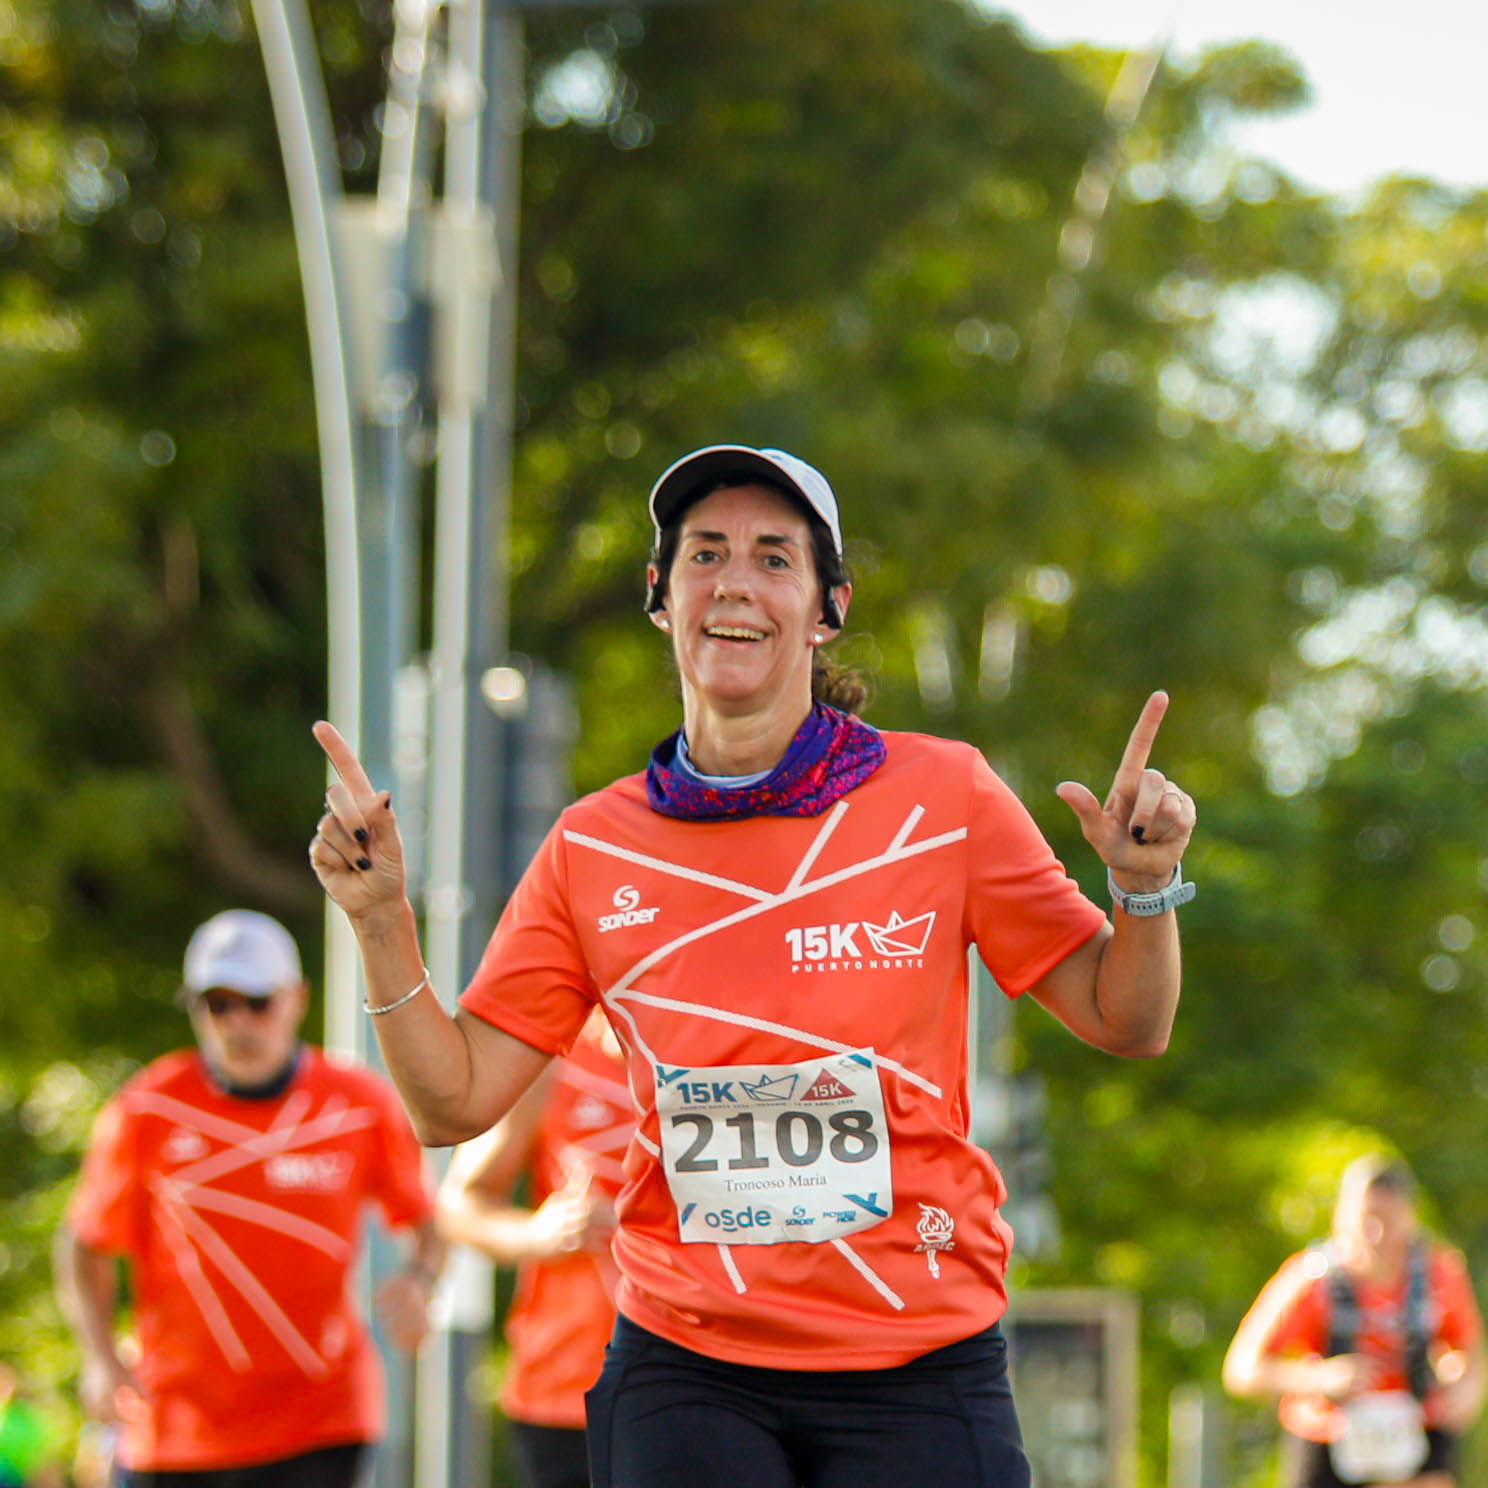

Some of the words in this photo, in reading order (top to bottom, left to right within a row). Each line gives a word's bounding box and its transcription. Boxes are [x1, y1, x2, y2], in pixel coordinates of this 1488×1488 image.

[785, 922, 862, 962] 15K
[791, 961, 862, 974] PUERTO
[869, 959, 924, 969] NORTE
[676, 1081, 739, 1104] 15K
[811, 1083, 844, 1097] 15K
[671, 1109, 879, 1173] 2108
[724, 1178, 786, 1193] Troncoso
[788, 1173, 828, 1188] Maria
[704, 1206, 772, 1231] osde
